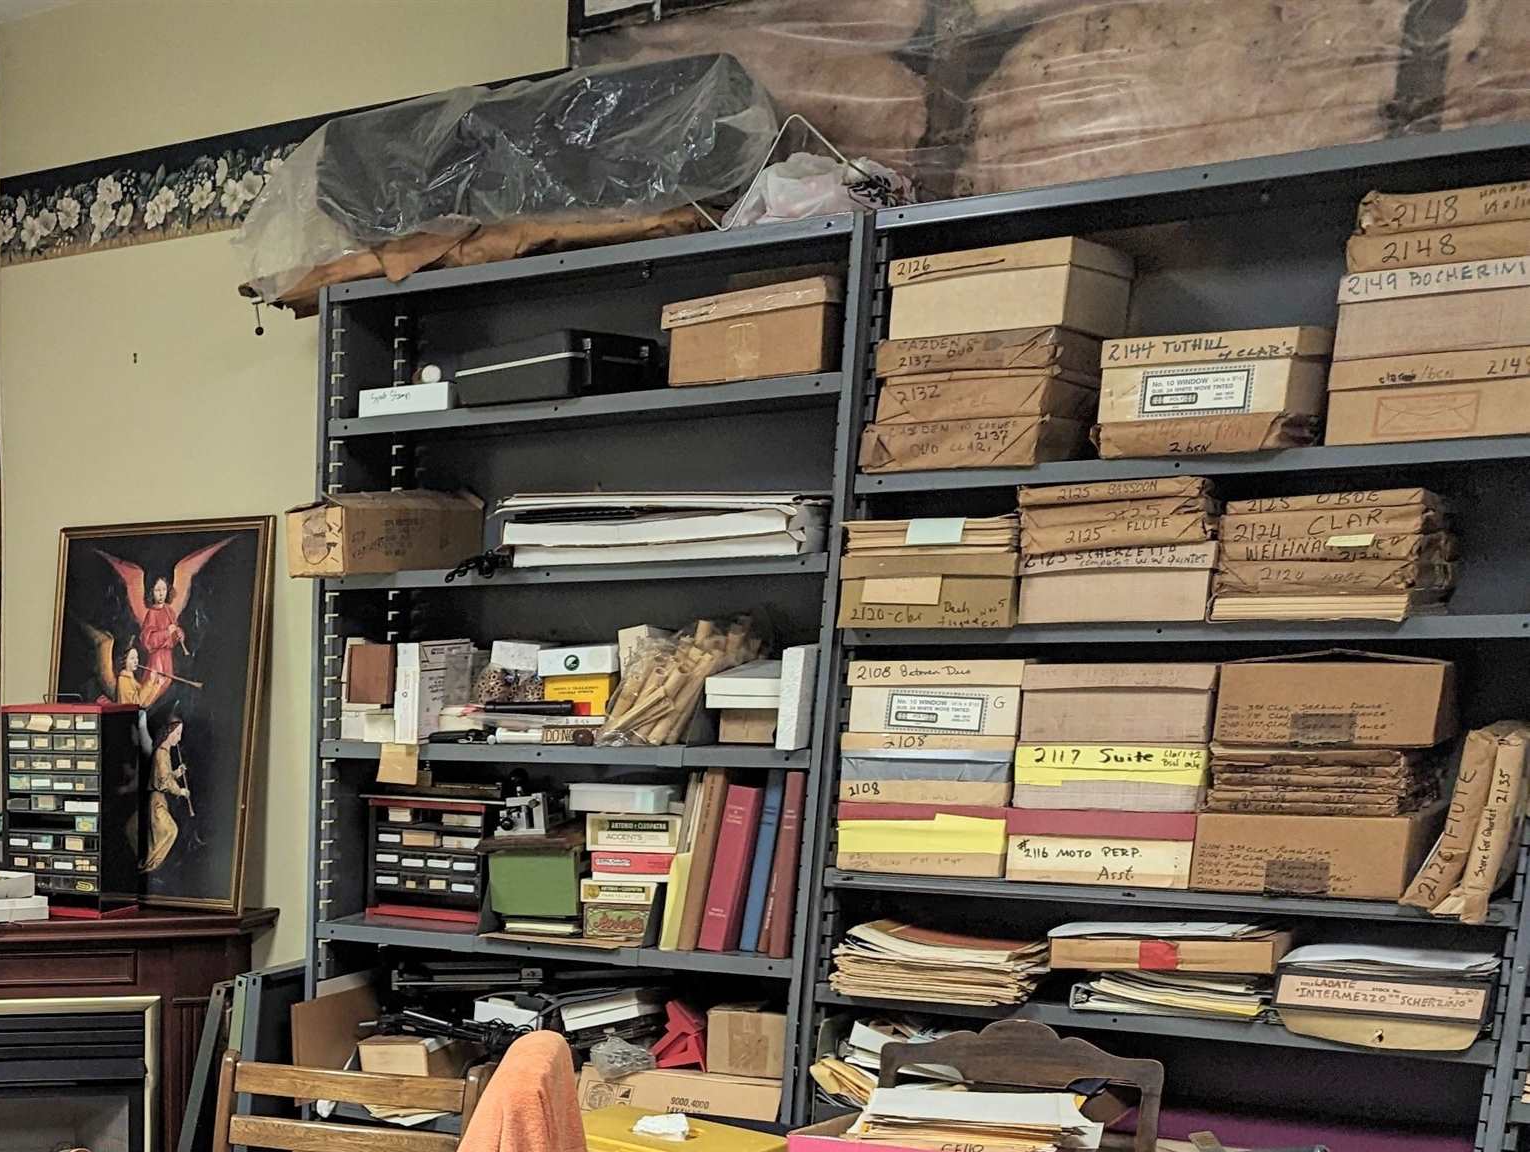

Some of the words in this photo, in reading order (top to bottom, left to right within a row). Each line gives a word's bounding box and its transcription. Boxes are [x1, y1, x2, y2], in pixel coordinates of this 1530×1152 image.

[1391, 195, 1458, 229] 2148
[1381, 232, 1457, 263] 2148
[897, 258, 931, 276] 2126
[1348, 273, 1397, 295] 2149
[1409, 261, 1526, 286] BOCHERINI
[1108, 342, 1156, 361] 2144
[1161, 336, 1229, 354] TUTHILL
[899, 354, 933, 368] 2137
[1176, 376, 1209, 386] WINDOW
[974, 429, 1009, 445] 2137
[1056, 488, 1091, 500] 2125
[1107, 480, 1158, 495] BASSOON
[1064, 525, 1107, 544] 2125
[1126, 517, 1171, 532] FLUTE
[1234, 522, 1282, 543] 2124
[1307, 508, 1390, 536] CLAR.
[857, 665, 891, 680] 2108
[993, 696, 1005, 709] G
[1034, 747, 1081, 764] 2117
[1099, 748, 1154, 764] Suite
[849, 782, 881, 796] 2108
[1496, 768, 1511, 804] 2135
[606, 833, 643, 841] ACCENTS
[1056, 848, 1092, 858] MOTO
[1101, 846, 1143, 858] PERP.
[1418, 850, 1455, 901] 2126
